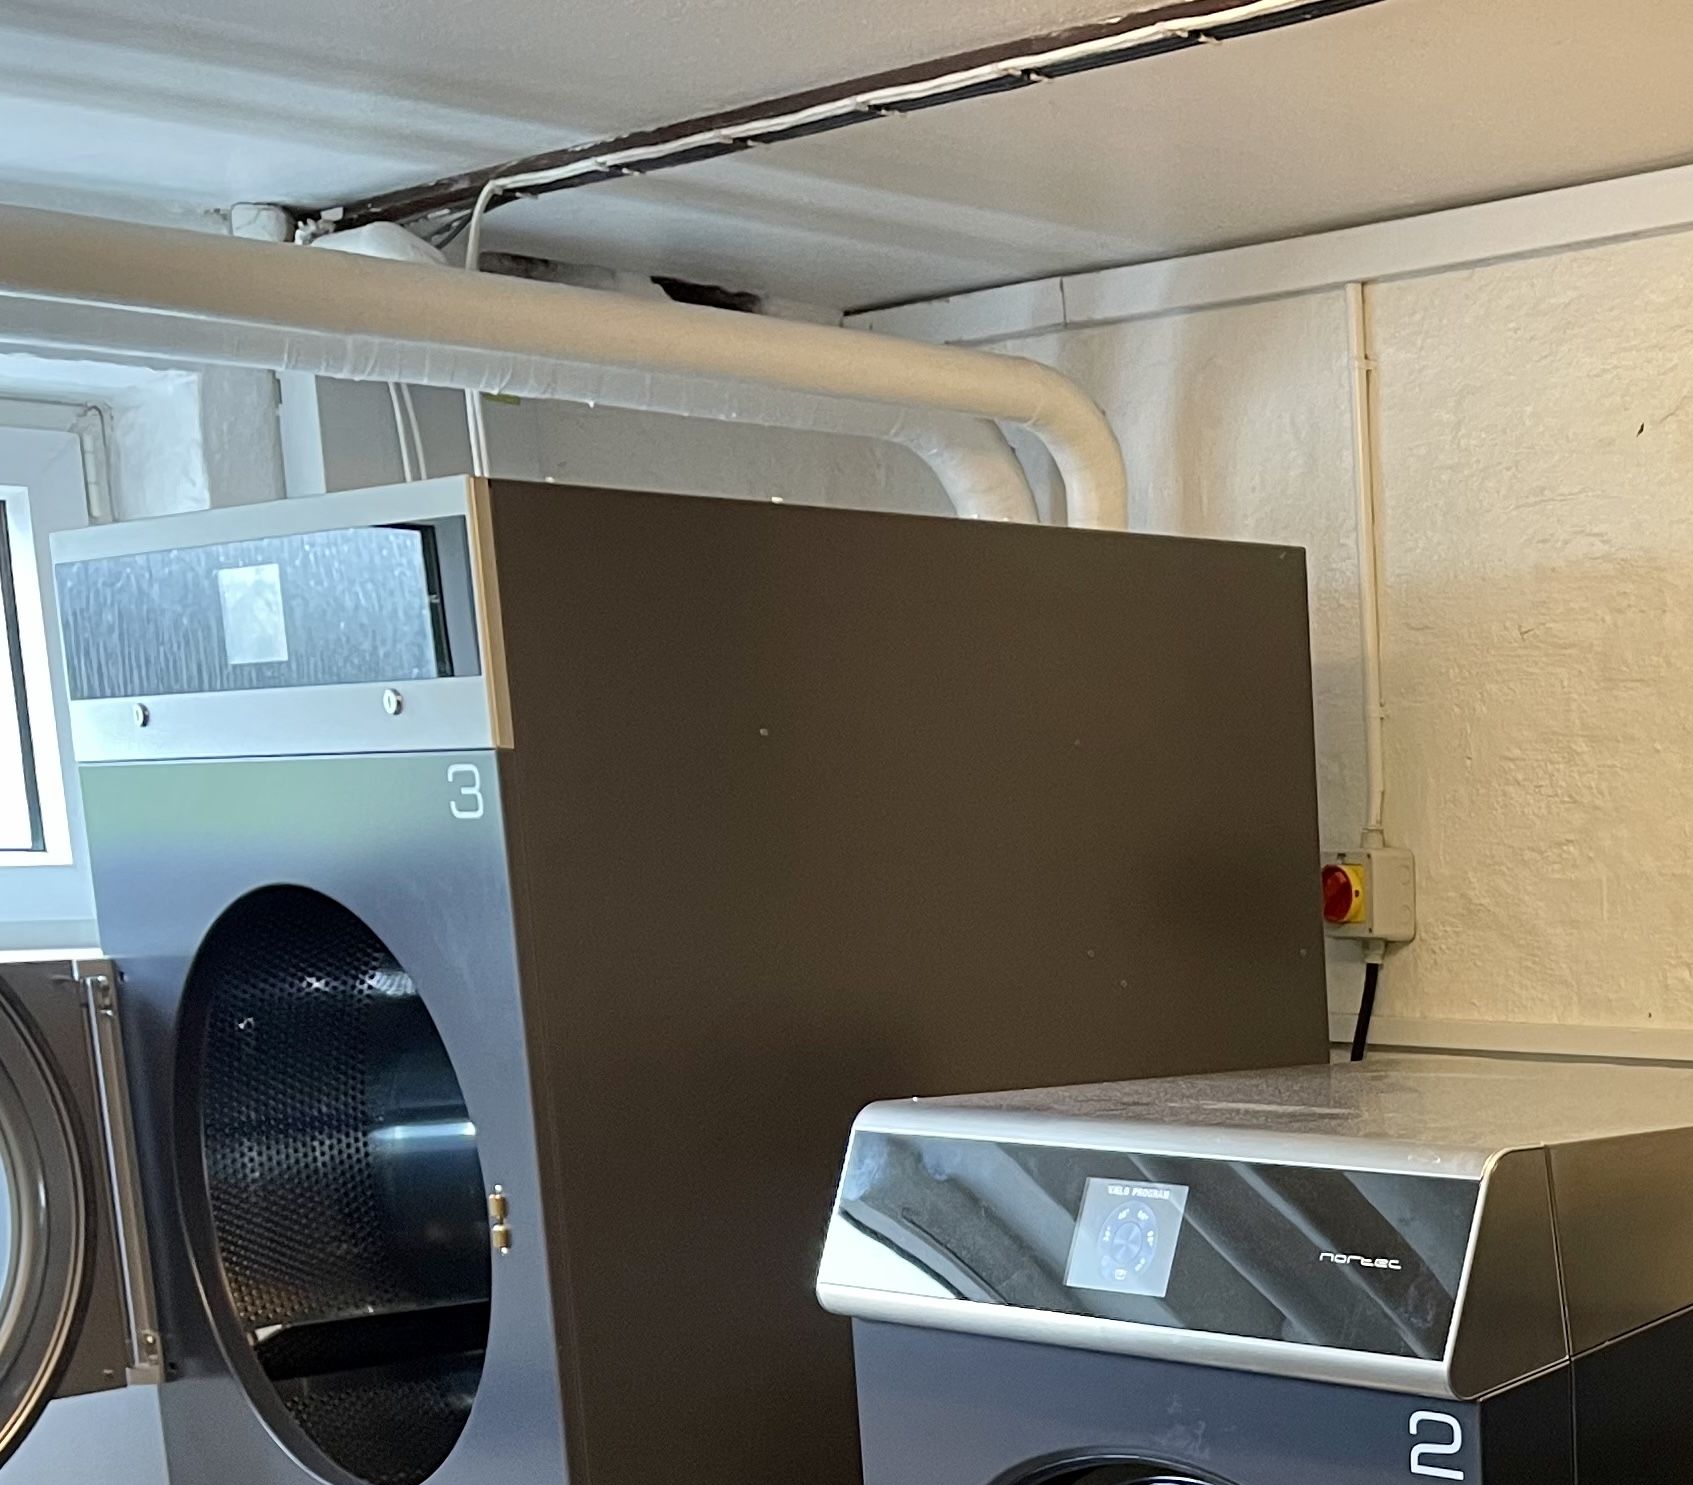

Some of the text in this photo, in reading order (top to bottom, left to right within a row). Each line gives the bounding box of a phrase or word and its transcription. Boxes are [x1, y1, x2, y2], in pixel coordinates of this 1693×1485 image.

[447, 762, 484, 820] 3
[1319, 1252, 1402, 1270] nortec
[1409, 1410, 1465, 1481] 2
